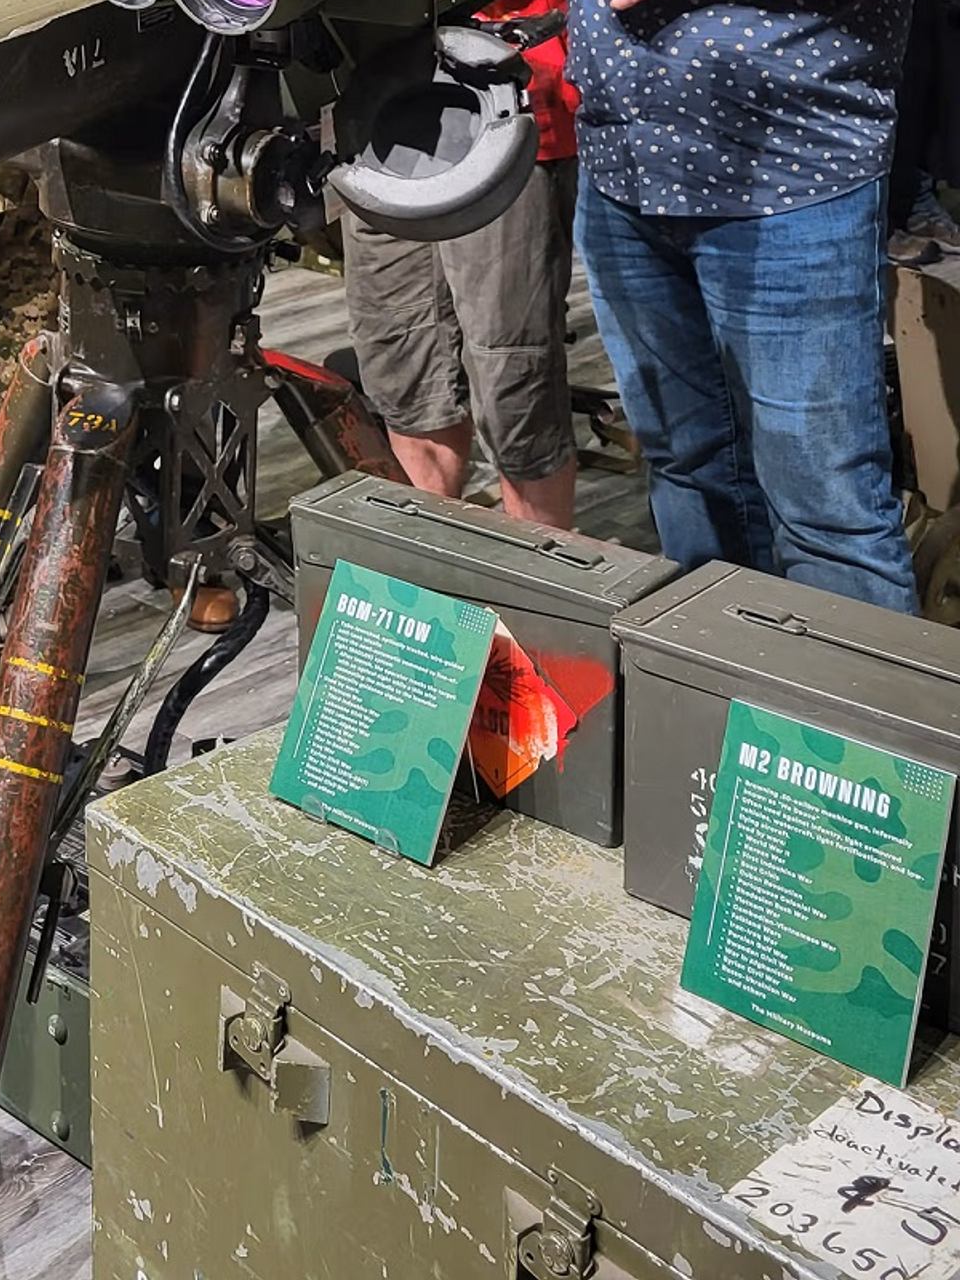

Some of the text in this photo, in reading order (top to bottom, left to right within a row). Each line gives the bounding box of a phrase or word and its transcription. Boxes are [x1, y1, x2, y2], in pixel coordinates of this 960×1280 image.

[335, 592, 394, 631] BGM-71
[394, 613, 432, 645] TOW
[737, 741, 892, 819] M2 BROWNING
[744, 833, 768, 848] World
[767, 842, 783, 854] War
[741, 851, 759, 864] First
[796, 872, 813, 885] War
[769, 853, 785, 865] War
[733, 894, 780, 919] Vietnam War
[778, 894, 811, 913] Colonial
[810, 907, 827, 920] War
[792, 909, 809, 921] War
[755, 940, 772, 954] Gulf
[772, 948, 788, 961] War
[762, 934, 778, 947] War
[820, 939, 837, 953] War
[724, 946, 794, 983] War in Afghanistan
[759, 952, 777, 966] Civil
[777, 959, 794, 973] War
[746, 965, 764, 979] Civil
[764, 973, 780, 986] War
[726, 976, 767, 1000] and others
[780, 990, 797, 1003] War
[750, 1002, 833, 1047] The Military Museums
